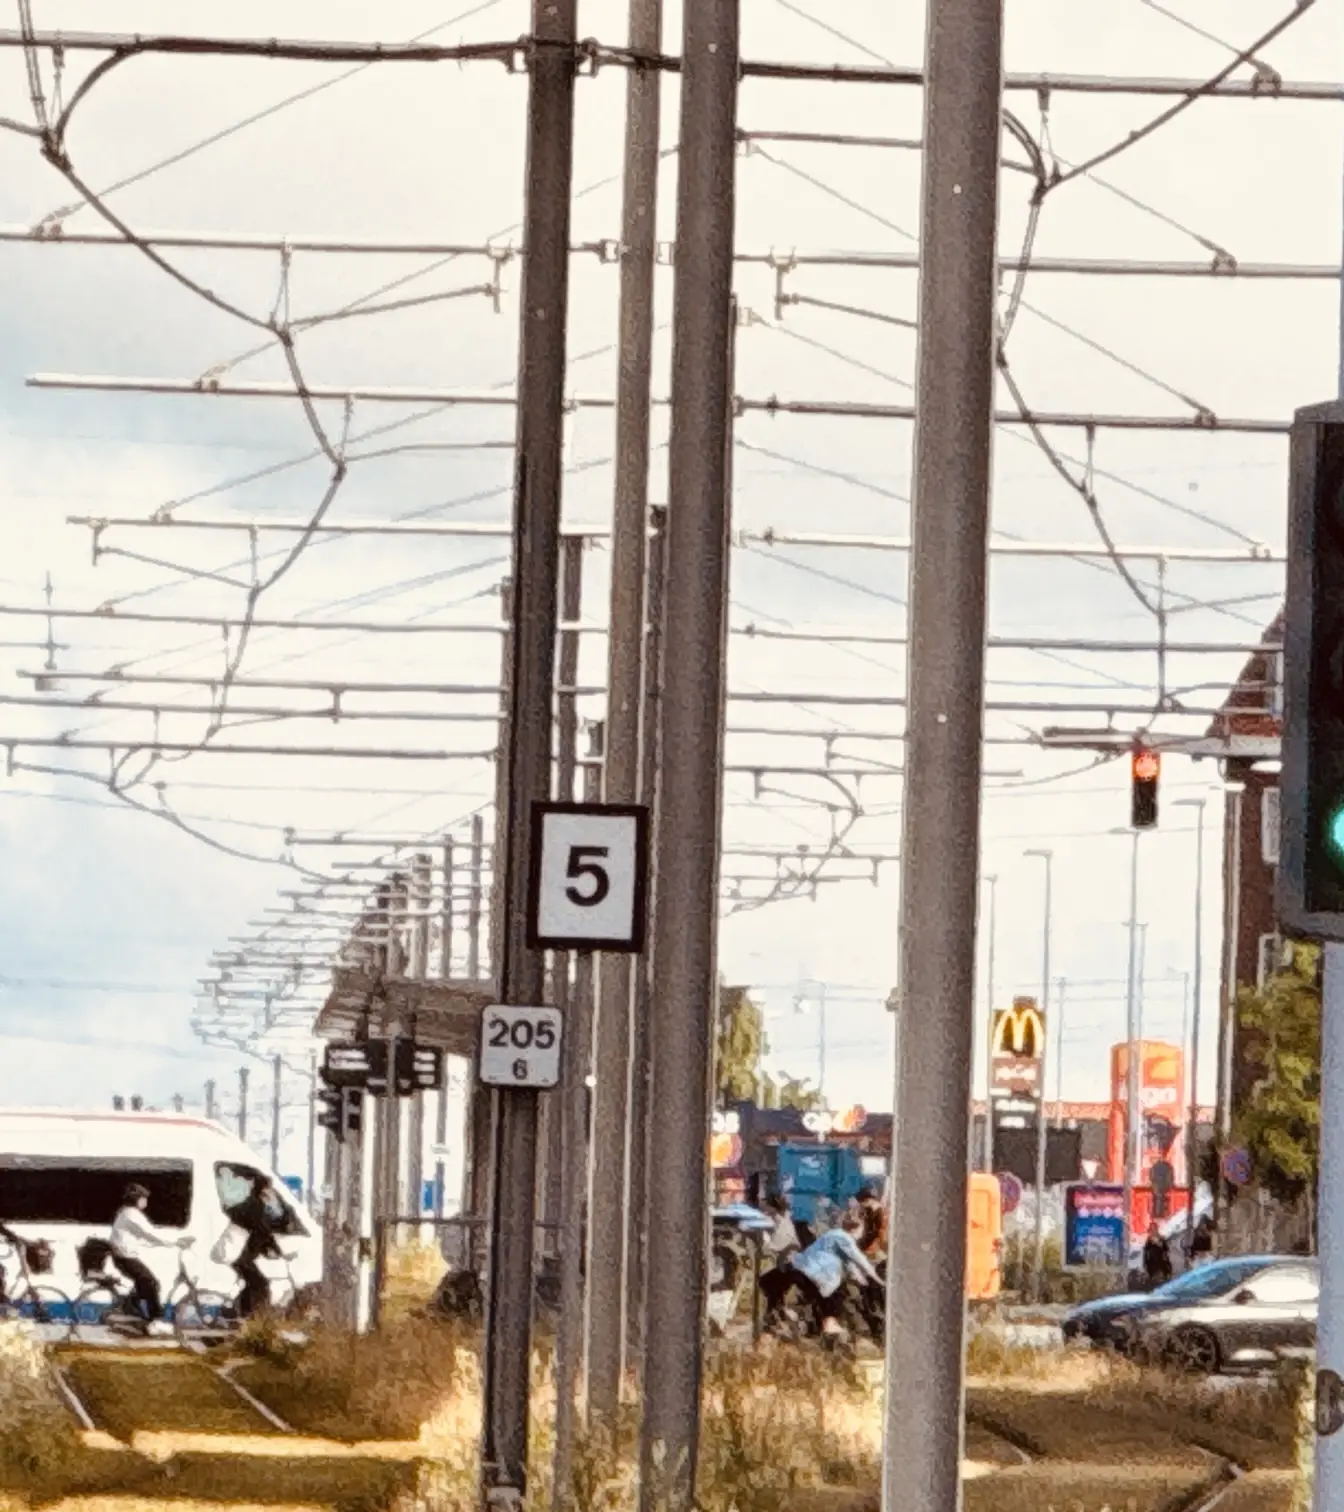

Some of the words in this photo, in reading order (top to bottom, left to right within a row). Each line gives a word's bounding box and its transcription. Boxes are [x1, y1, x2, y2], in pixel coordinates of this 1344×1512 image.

[565, 846, 610, 906] 5
[488, 1019, 556, 1050] 205
[512, 1059, 528, 1081] 6
